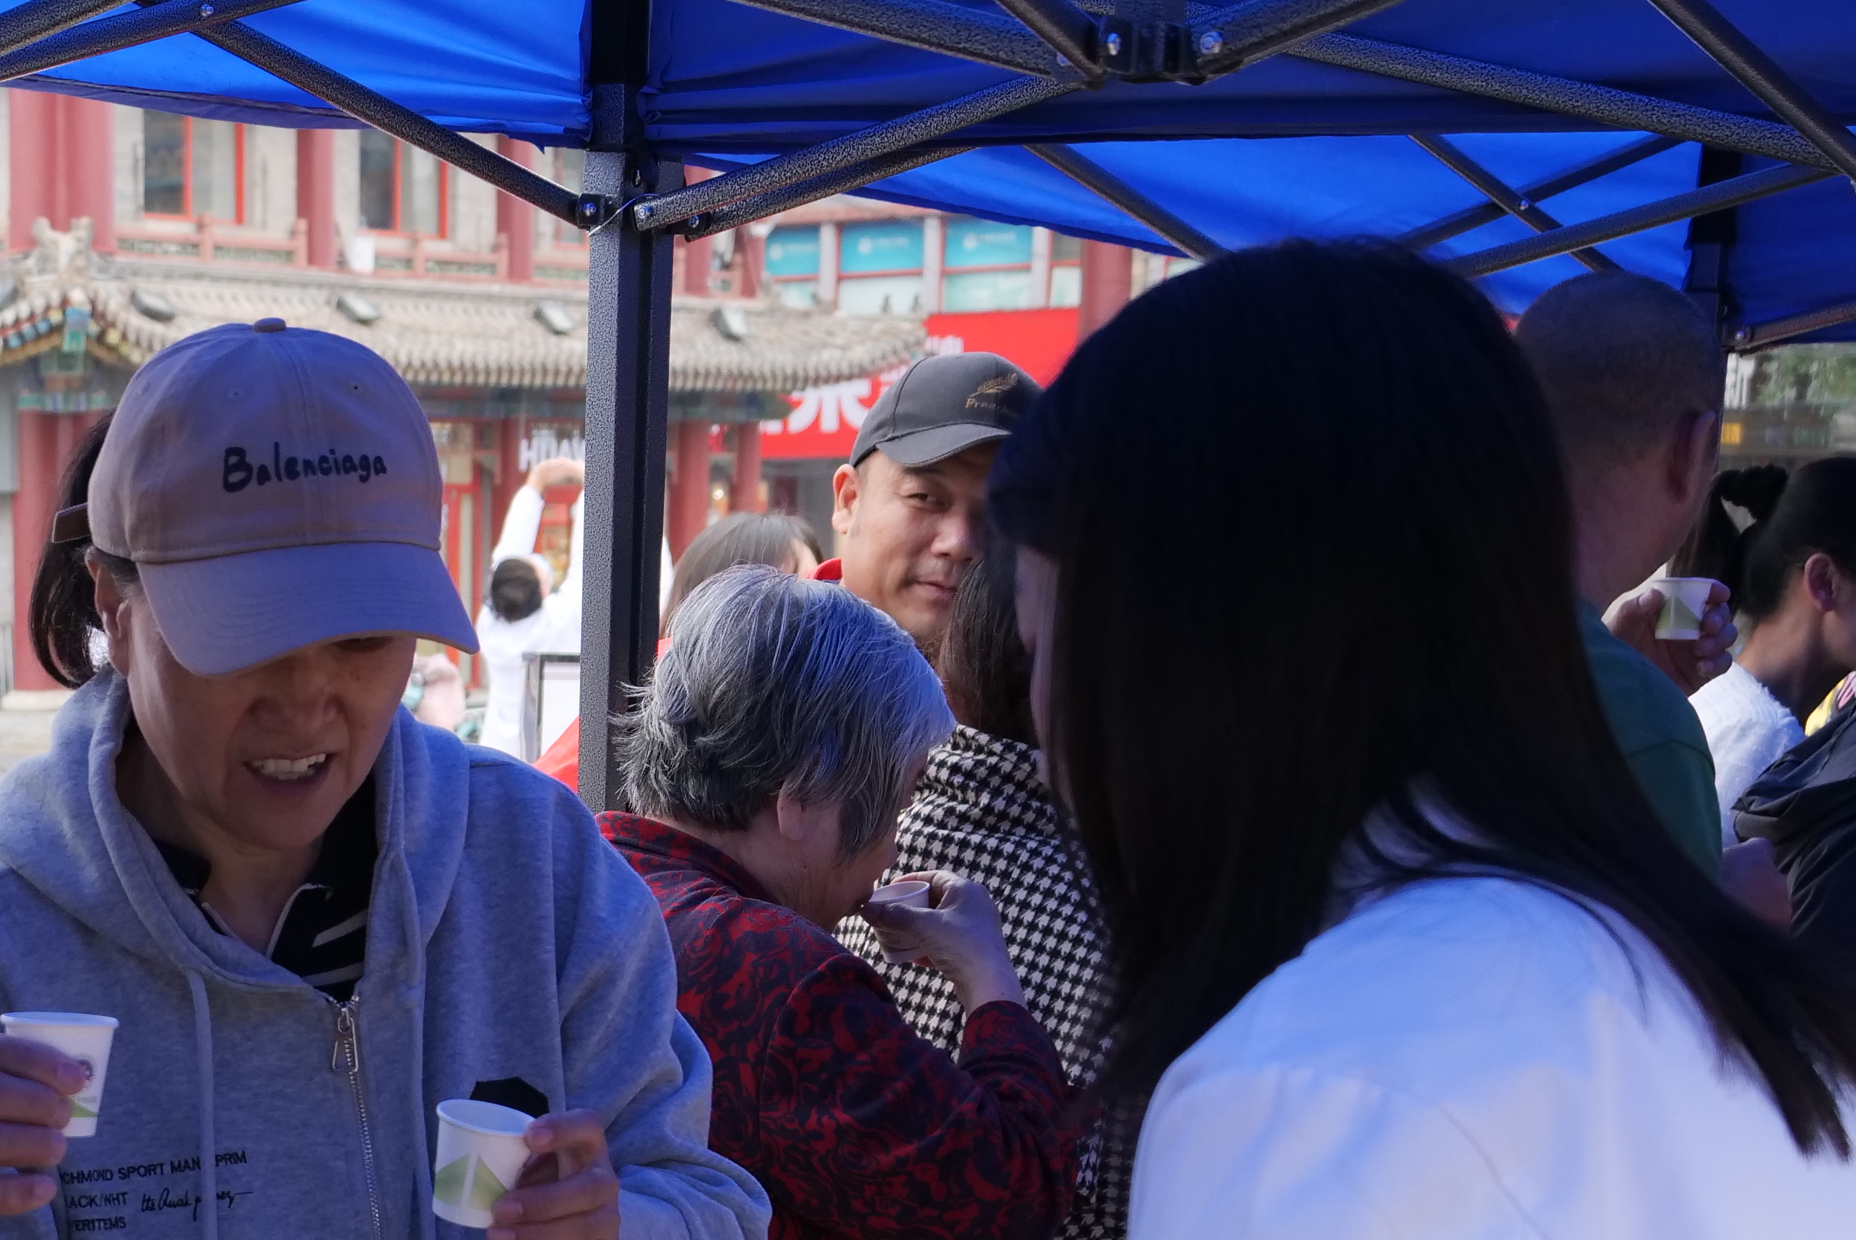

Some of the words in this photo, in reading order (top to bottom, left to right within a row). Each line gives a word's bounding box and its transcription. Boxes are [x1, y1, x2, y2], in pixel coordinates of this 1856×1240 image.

[222, 442, 387, 493] Balenciaga
[118, 1162, 165, 1181] SPORT
[170, 1156, 201, 1174] MAN
